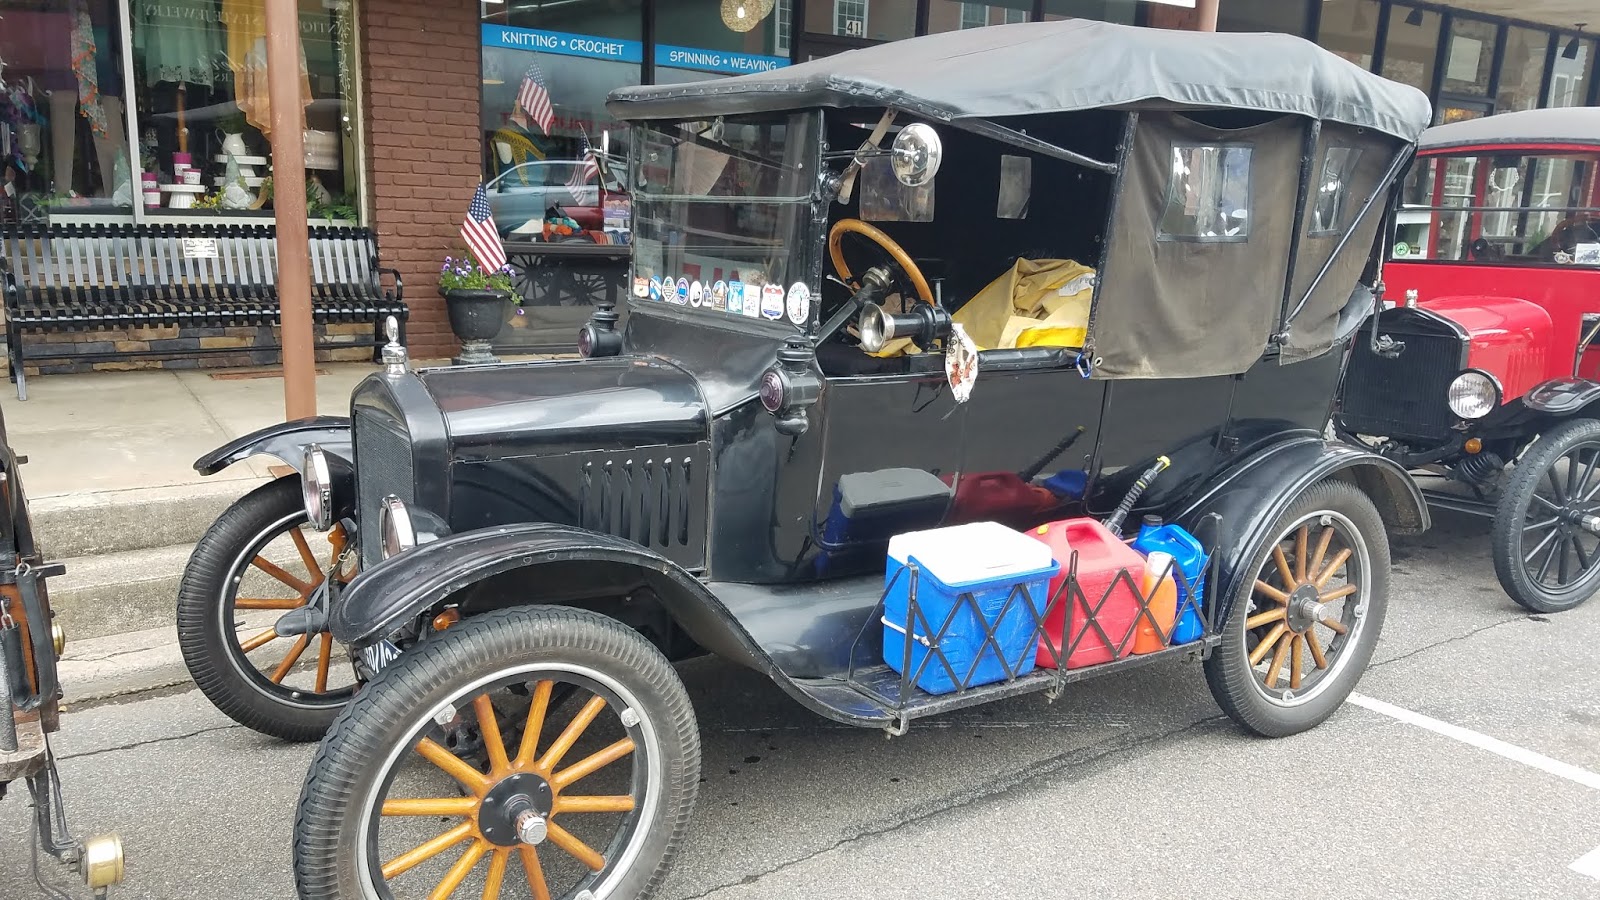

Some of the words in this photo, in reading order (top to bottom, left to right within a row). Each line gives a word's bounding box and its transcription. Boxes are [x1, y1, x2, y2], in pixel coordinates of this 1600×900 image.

[846, 21, 859, 35] 41
[501, 31, 558, 48] KNITTING
[569, 39, 625, 56] CROCHET
[669, 50, 720, 67] SPINNING
[730, 56, 777, 72] WEAVING
